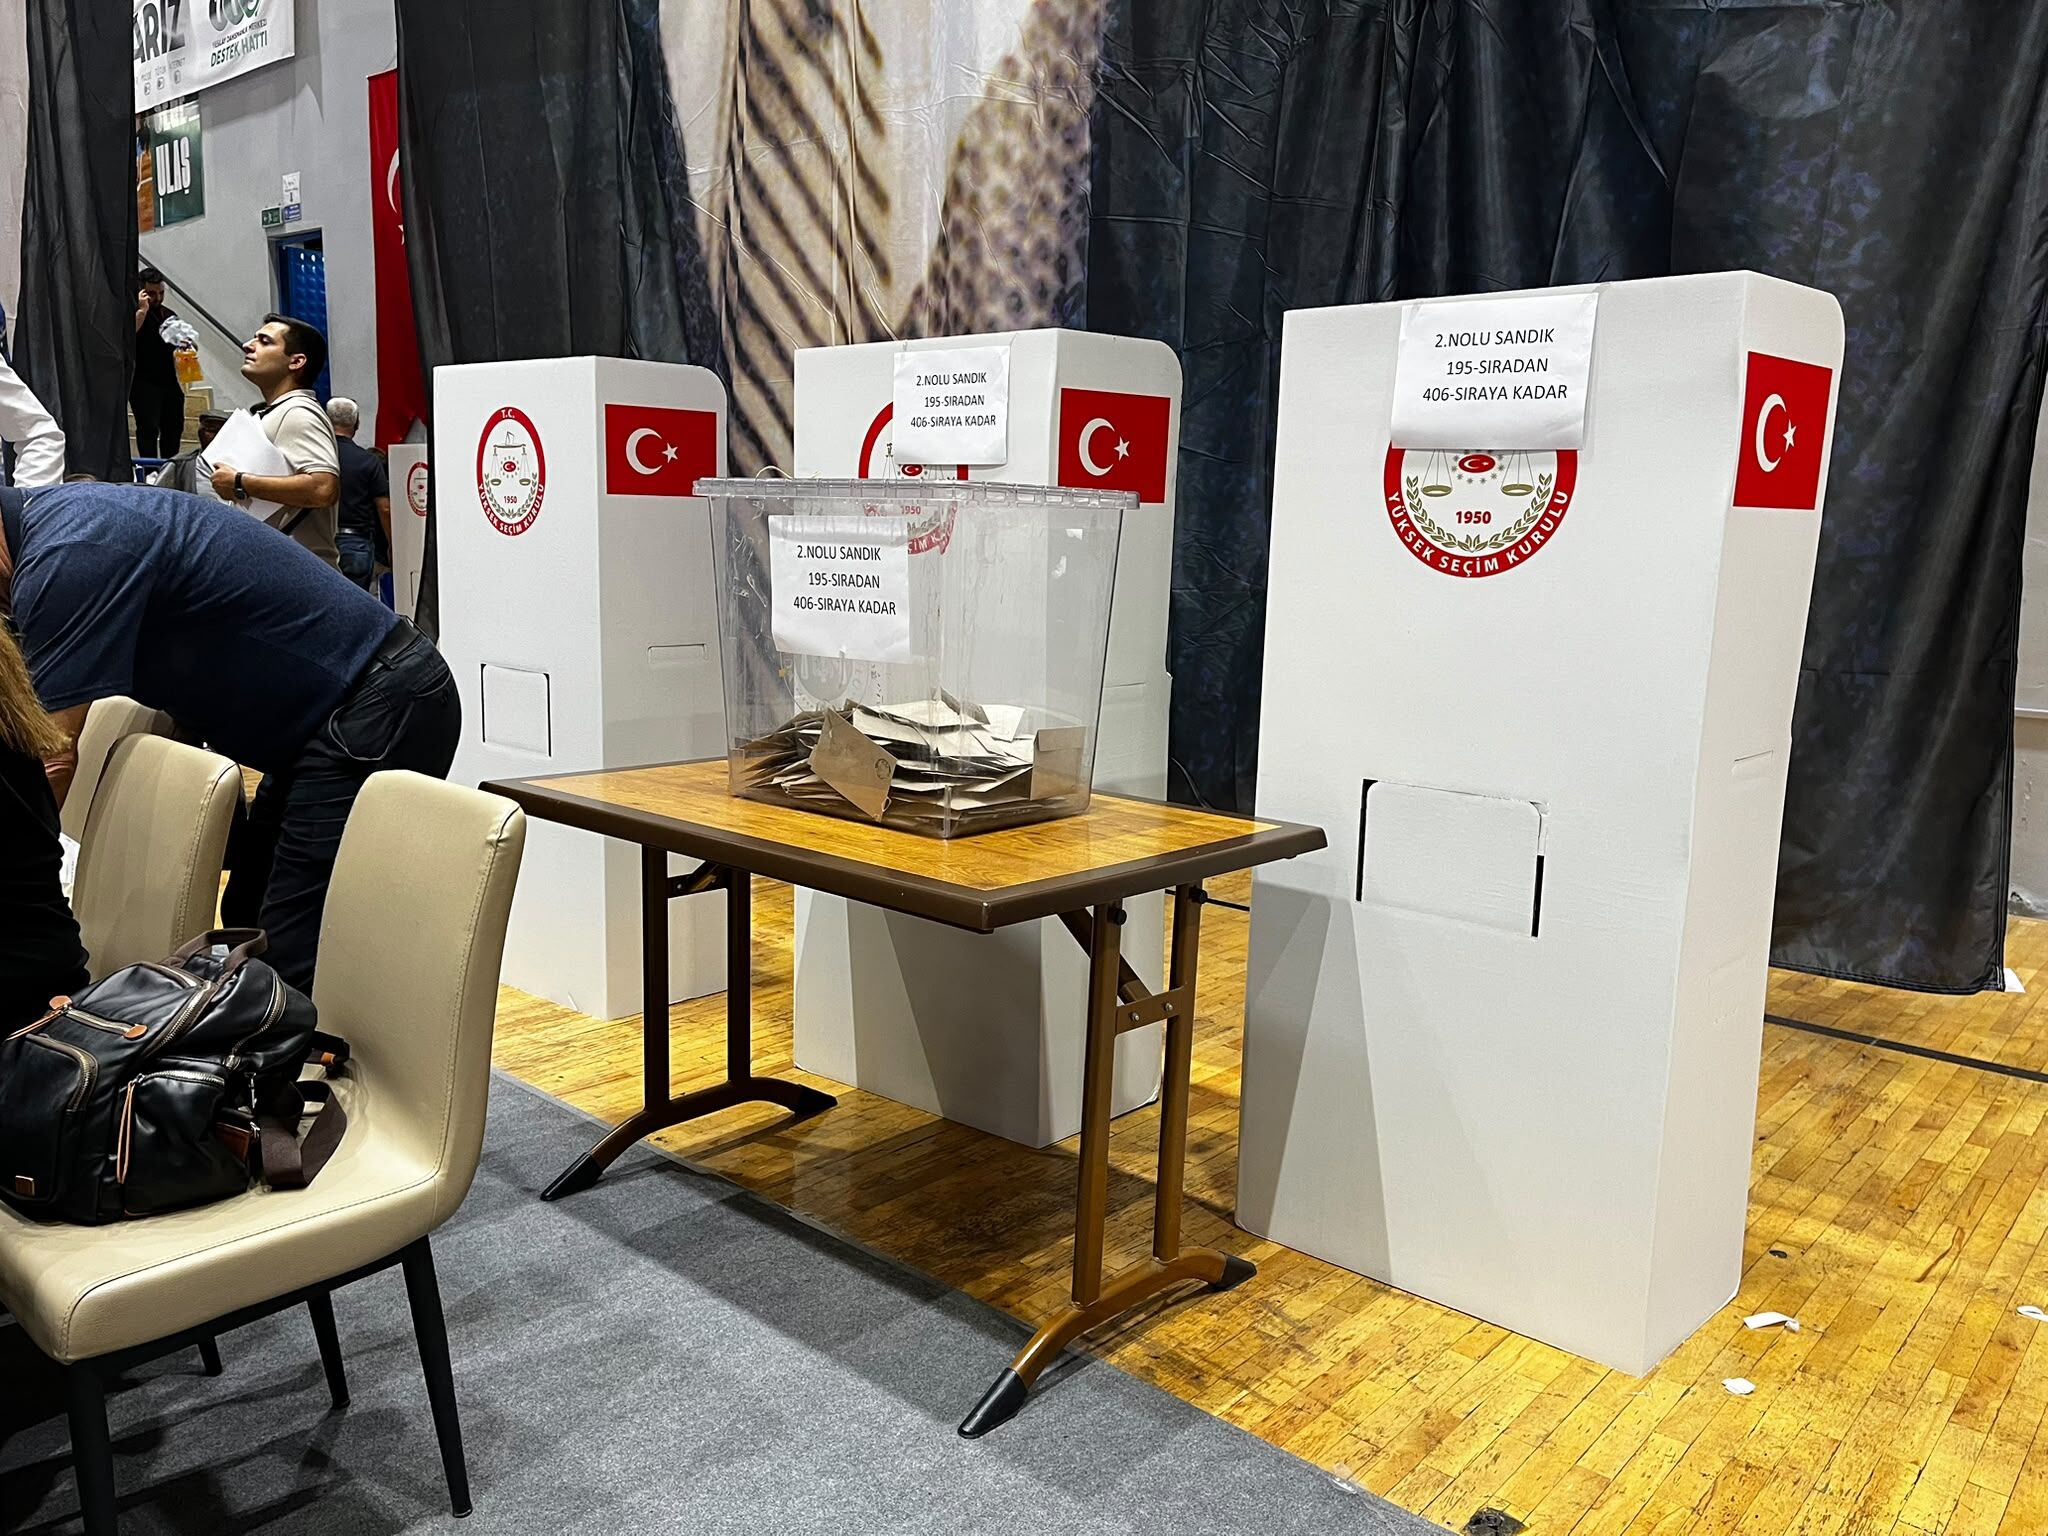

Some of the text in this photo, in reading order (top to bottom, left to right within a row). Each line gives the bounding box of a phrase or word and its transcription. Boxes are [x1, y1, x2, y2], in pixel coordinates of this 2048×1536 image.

[210, 41, 240, 67] DESTEK
[241, 30, 268, 55] HATTI
[156, 136, 191, 195] ULAŞ
[1434, 328, 1555, 348] 2.NOLU SANDIK
[1446, 358, 1549, 376] 195-SIRADAN
[916, 372, 987, 387] 2.NOLU SANDIK
[1422, 384, 1568, 402] 406-SIRAYA KADAR
[924, 395, 985, 408] 195-SIRADAN
[501, 408, 515, 419] T.C.
[910, 415, 996, 428] 406-SIRAYA KADAR
[503, 495, 518, 504] 1950
[1455, 511, 1492, 525] 1950
[1388, 490, 1569, 577] YÜKSEK SEÇİM KURULU
[797, 545, 881, 561] 2.NOLU SANDIK
[908, 539, 928, 555] ÇİM
[808, 572, 880, 589] 195-SIRADAN
[793, 596, 897, 615] 406-SIRAYA KADAR
